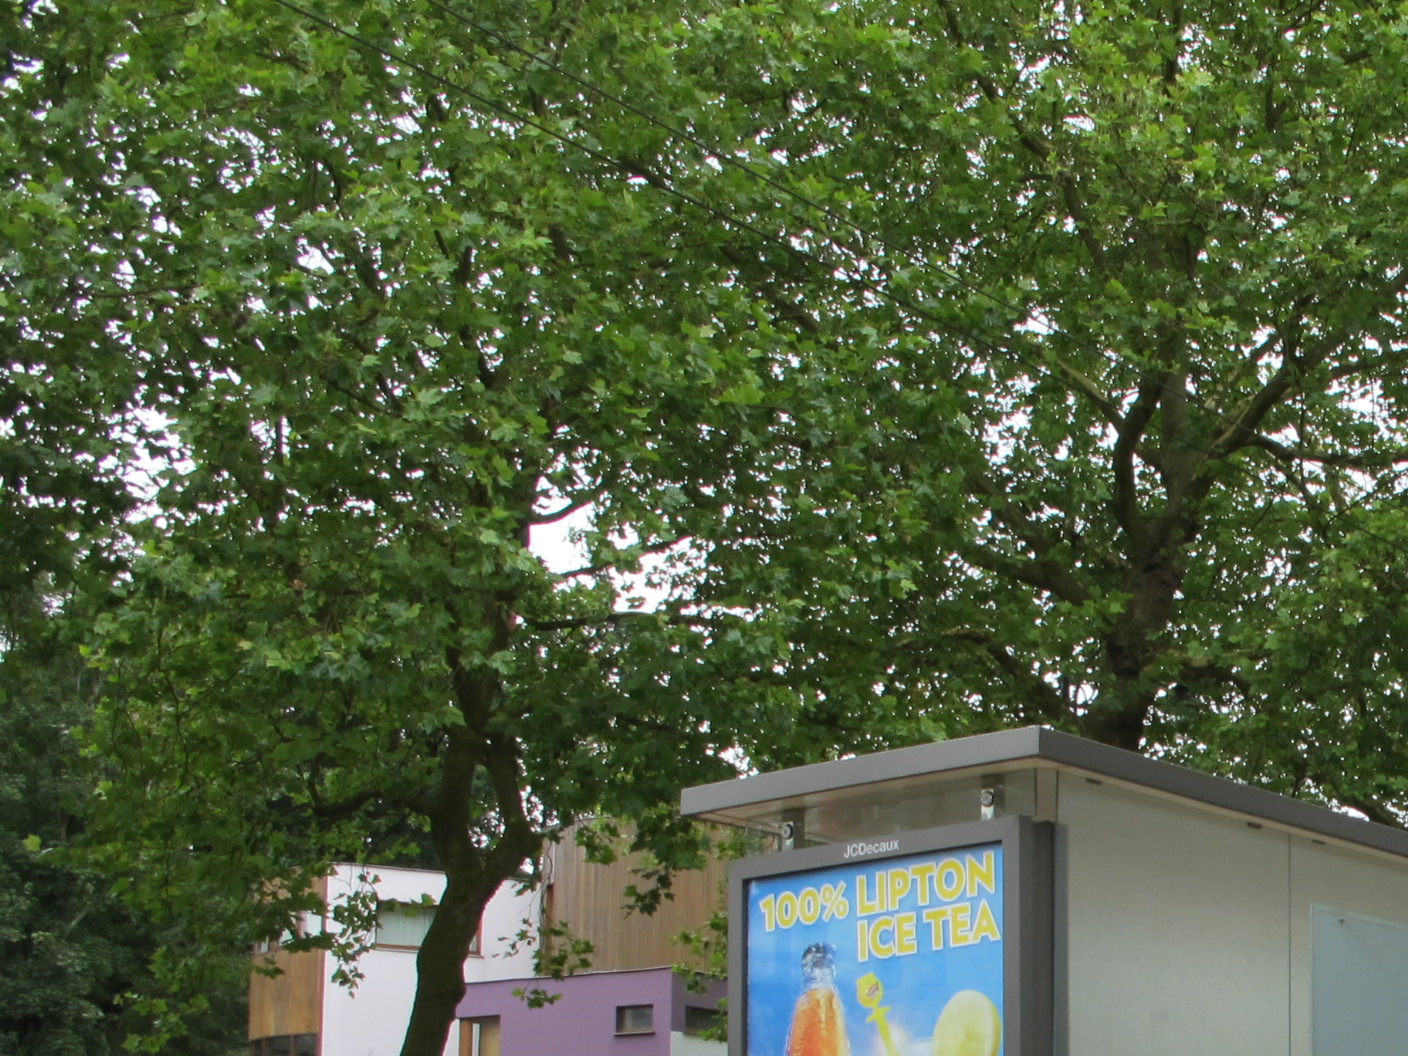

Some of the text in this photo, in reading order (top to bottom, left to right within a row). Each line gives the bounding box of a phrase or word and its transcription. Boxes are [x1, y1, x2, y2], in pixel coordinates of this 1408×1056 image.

[843, 839, 900, 859] JCDecaux
[758, 850, 996, 933] 100% LIPTON
[856, 898, 1001, 963] ICE TEA
